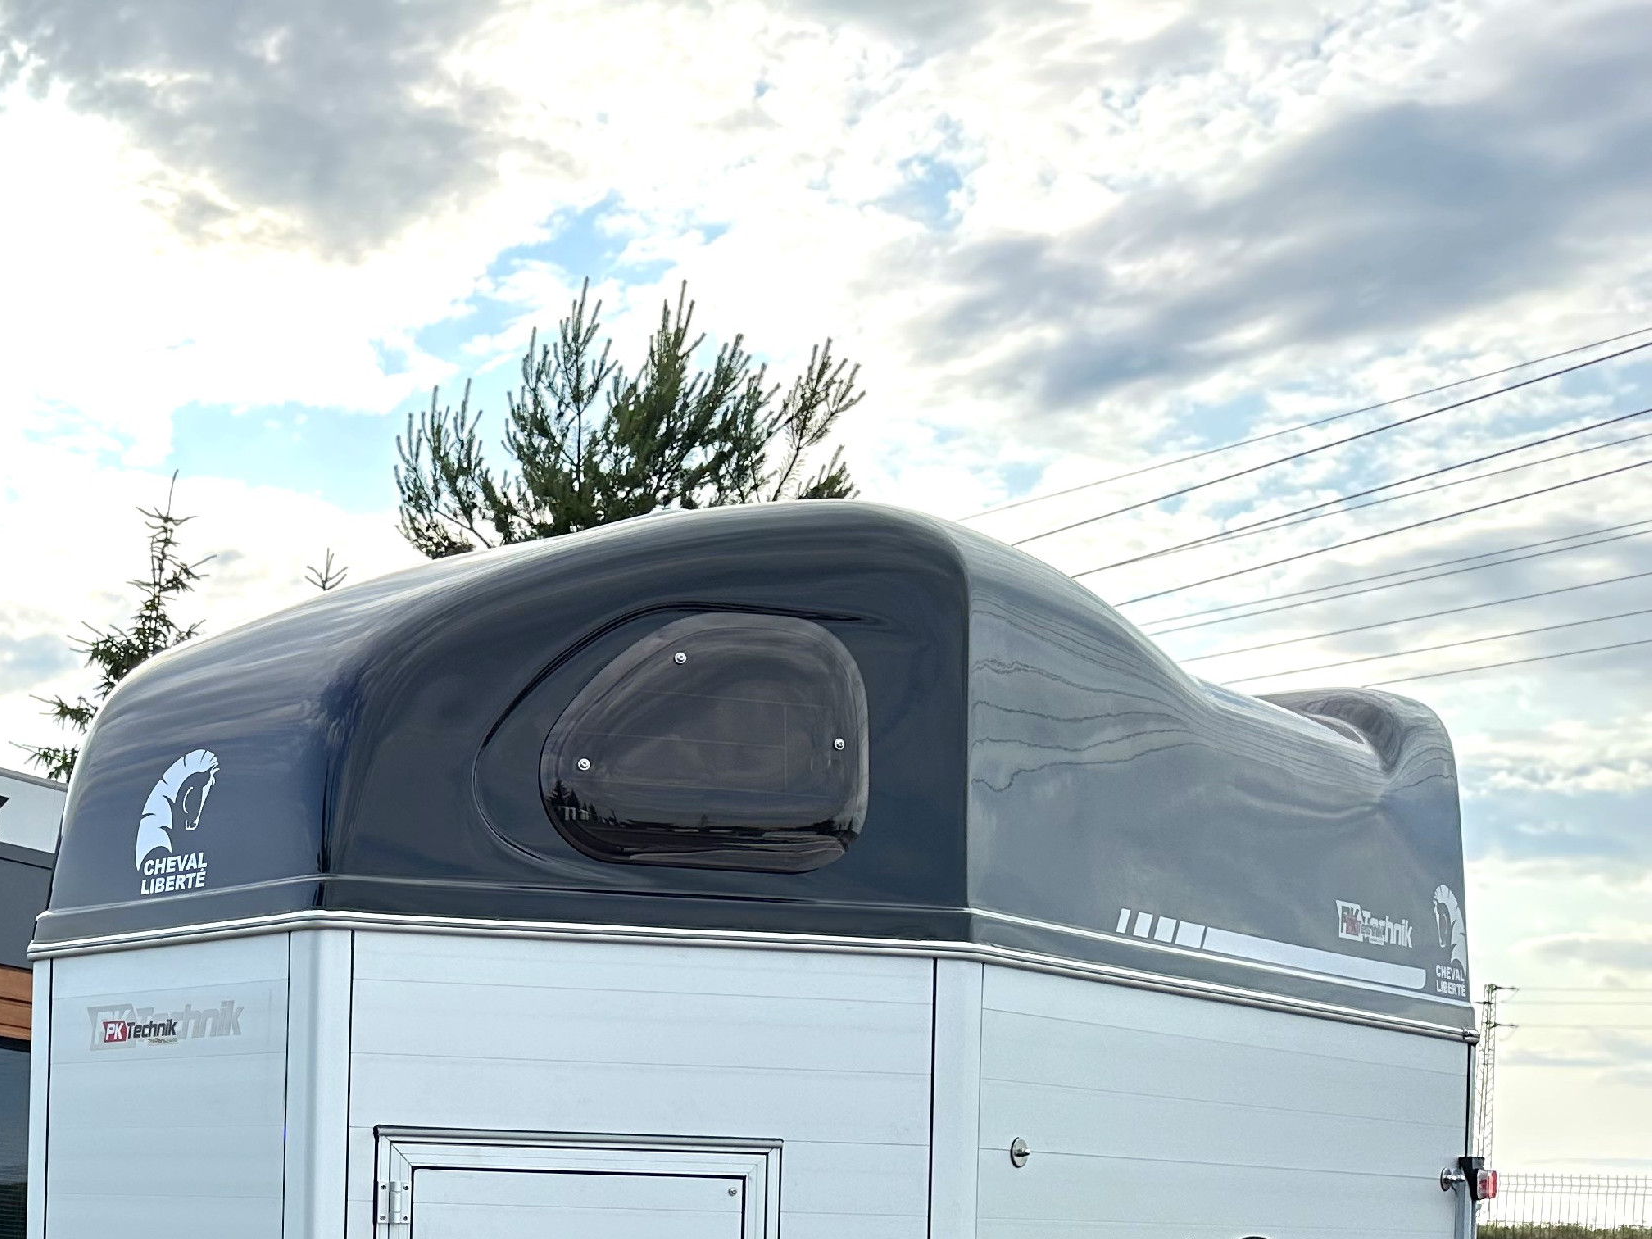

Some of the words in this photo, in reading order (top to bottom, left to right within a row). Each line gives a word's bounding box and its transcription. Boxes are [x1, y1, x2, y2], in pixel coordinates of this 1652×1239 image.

[144, 852, 208, 876] CHEVAL
[140, 868, 207, 895] LIBERTÉ
[1435, 964, 1465, 982] CHEVAL
